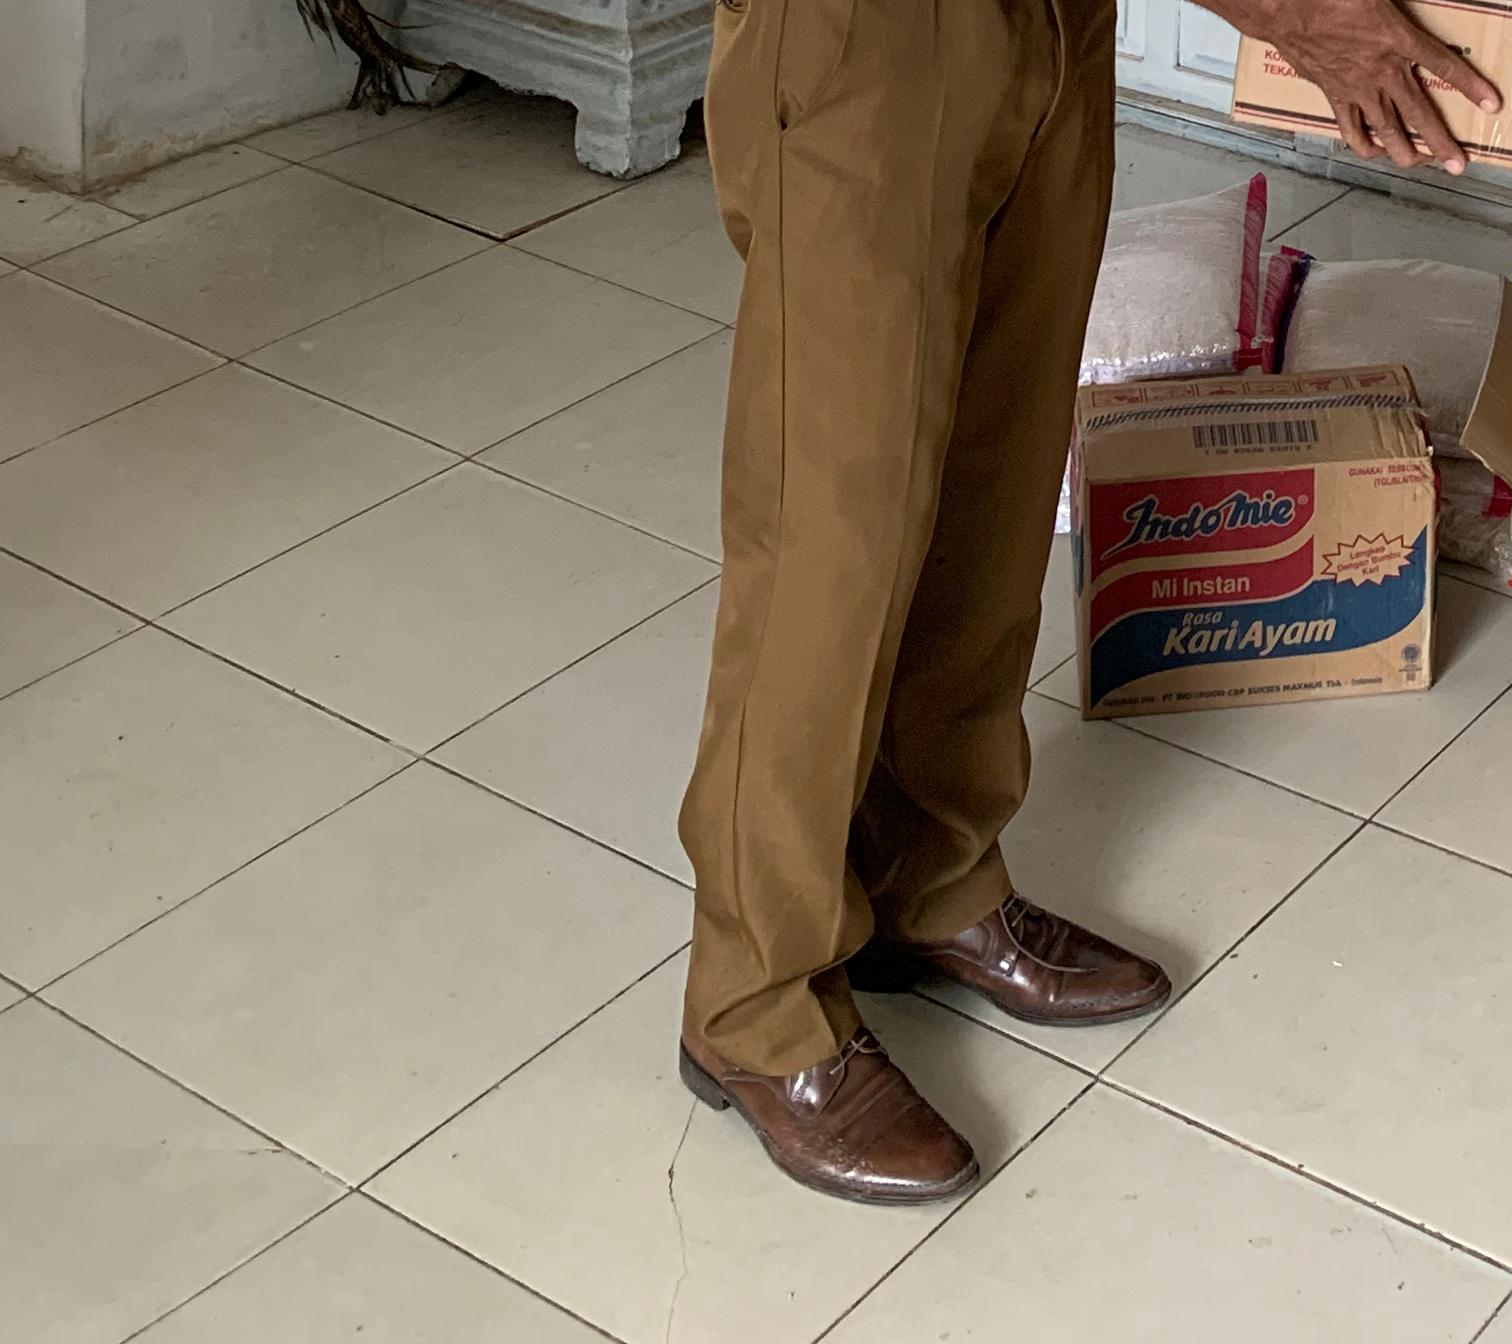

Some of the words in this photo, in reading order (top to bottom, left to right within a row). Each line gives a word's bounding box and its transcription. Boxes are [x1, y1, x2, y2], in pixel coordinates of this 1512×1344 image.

[1152, 579, 1178, 599] Mi
[1183, 575, 1250, 597] Instan
[1182, 611, 1223, 627] Rasa
[1163, 620, 1239, 656] Kari
[1241, 616, 1338, 657] Ayam
